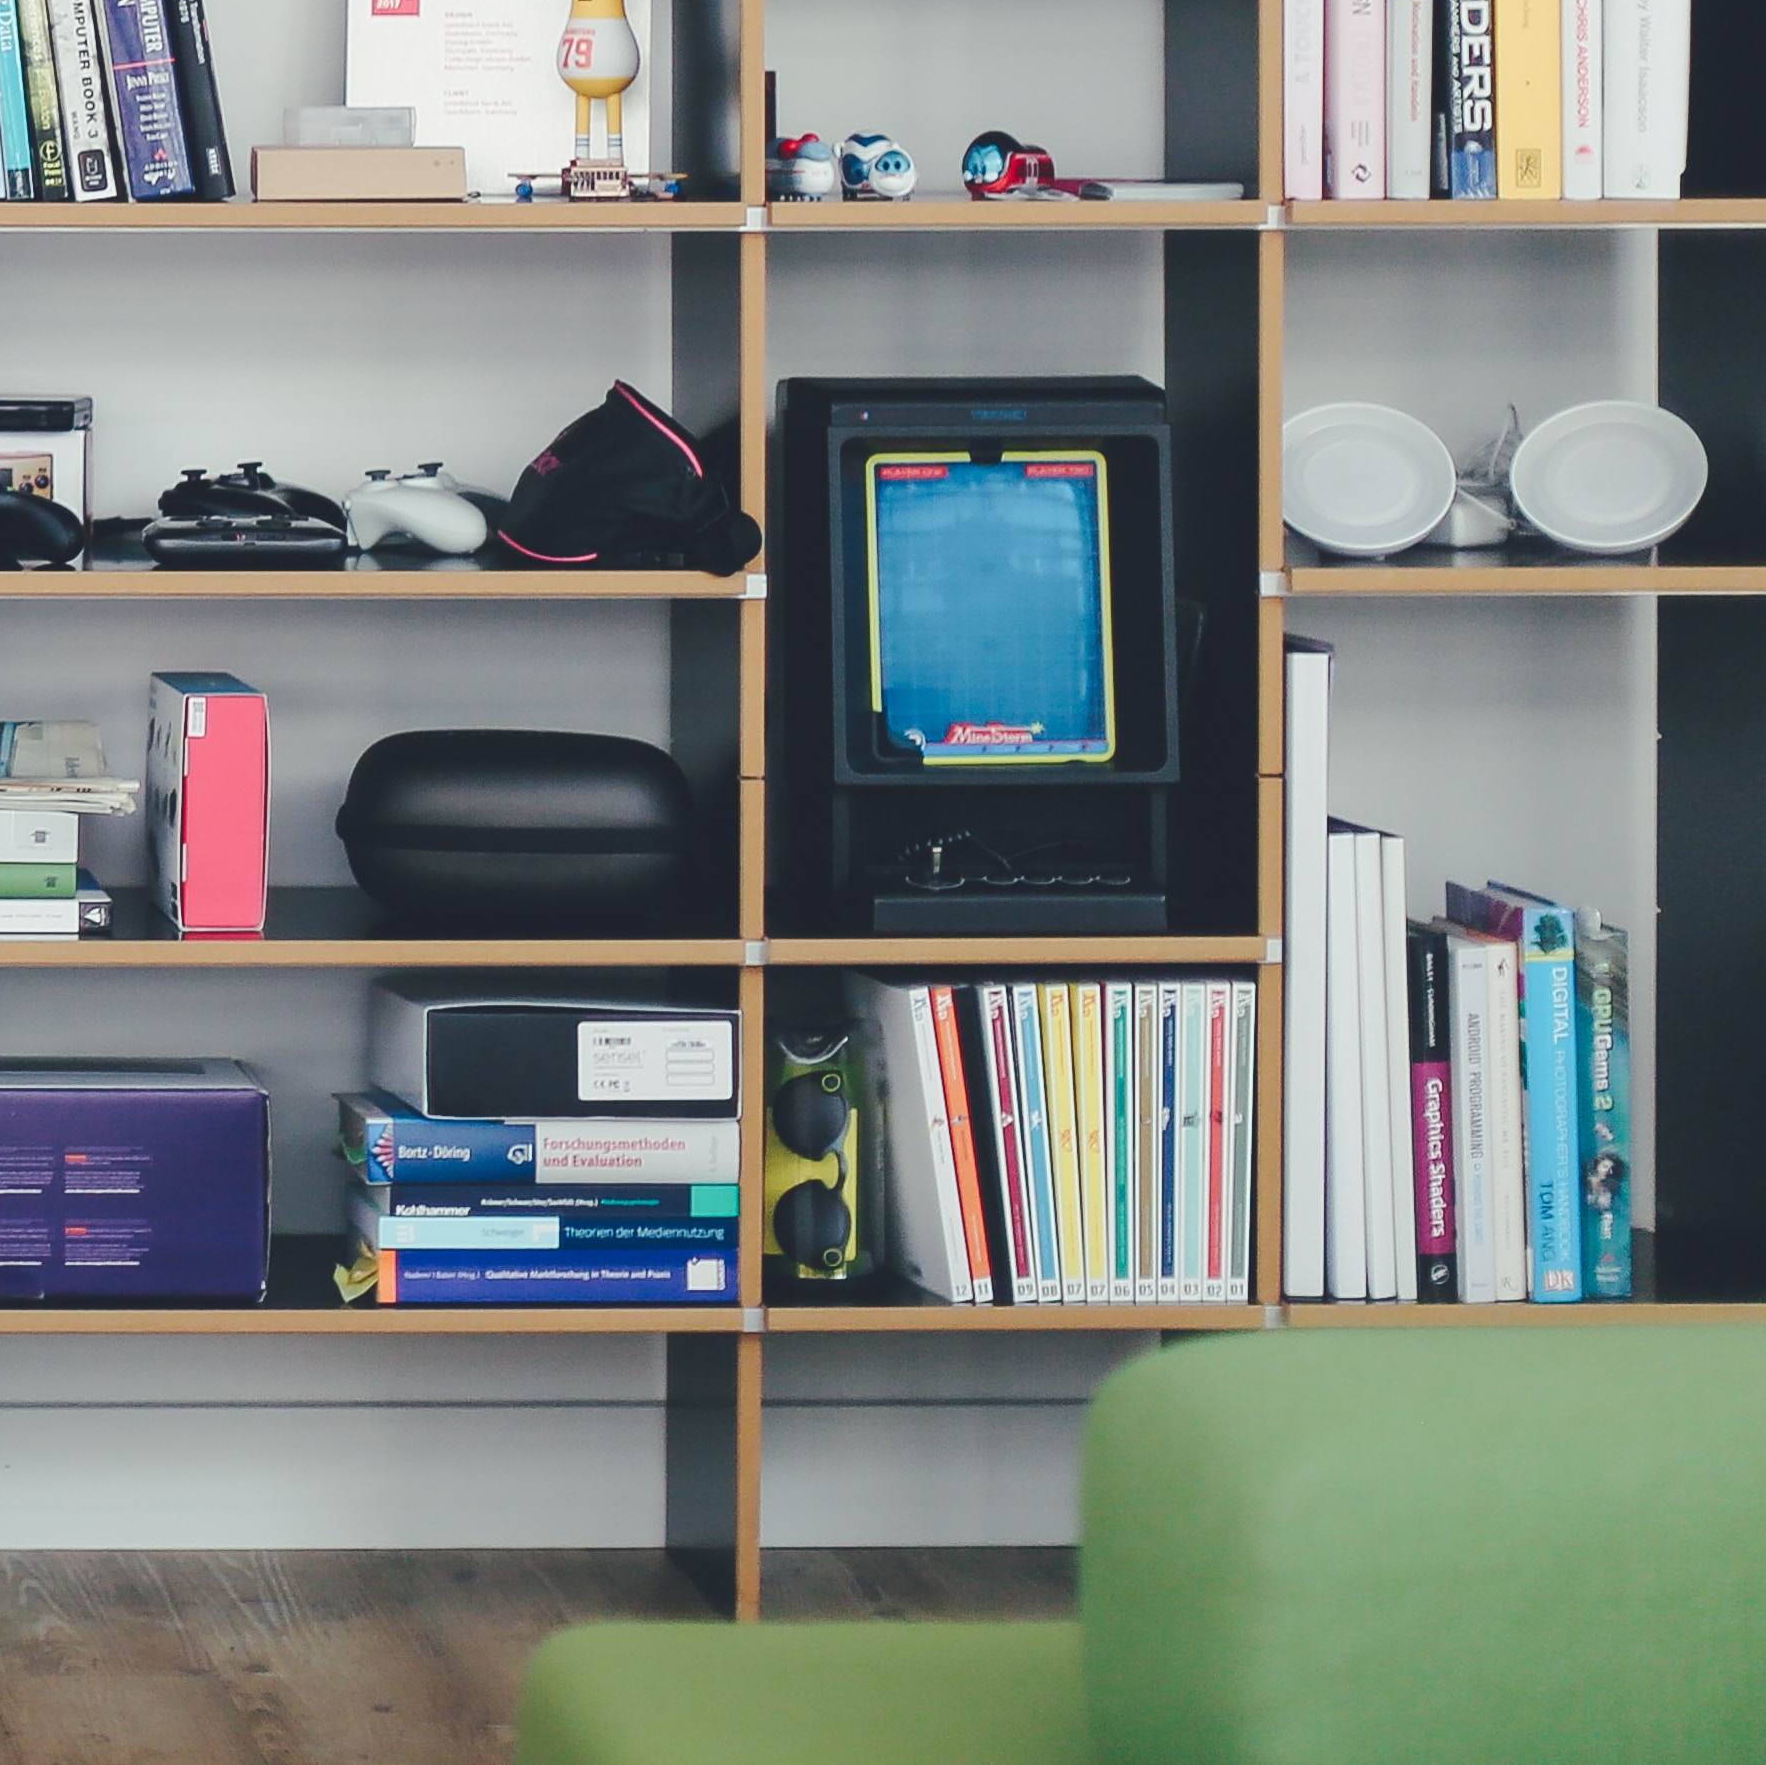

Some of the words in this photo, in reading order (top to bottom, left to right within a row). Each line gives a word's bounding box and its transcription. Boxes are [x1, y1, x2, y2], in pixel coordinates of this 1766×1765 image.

[562, 38, 593, 68] 79
[1637, 15, 1651, 63] Walter
[82, 77, 97, 124] BOOK
[1576, 44, 1590, 129] ANDERSON
[1637, 65, 1649, 133] Isaacson
[87, 129, 99, 139] 3
[1552, 966, 1570, 1044] DIGITAL
[1424, 1078, 1446, 1158] Graphics
[543, 1137, 686, 1153] Forschungsmethoden
[543, 1155, 568, 1168] und
[571, 1154, 643, 1168] Evaluation
[1428, 1161, 1448, 1237] Shaders
[1539, 1179, 1556, 1220] TOM
[1556, 1182, 1571, 1263] HANDBOOK
[564, 1225, 615, 1238] Theorien
[616, 1225, 634, 1238] der
[637, 1225, 725, 1240] Mediennutzung
[1540, 1224, 1557, 1262] ANG
